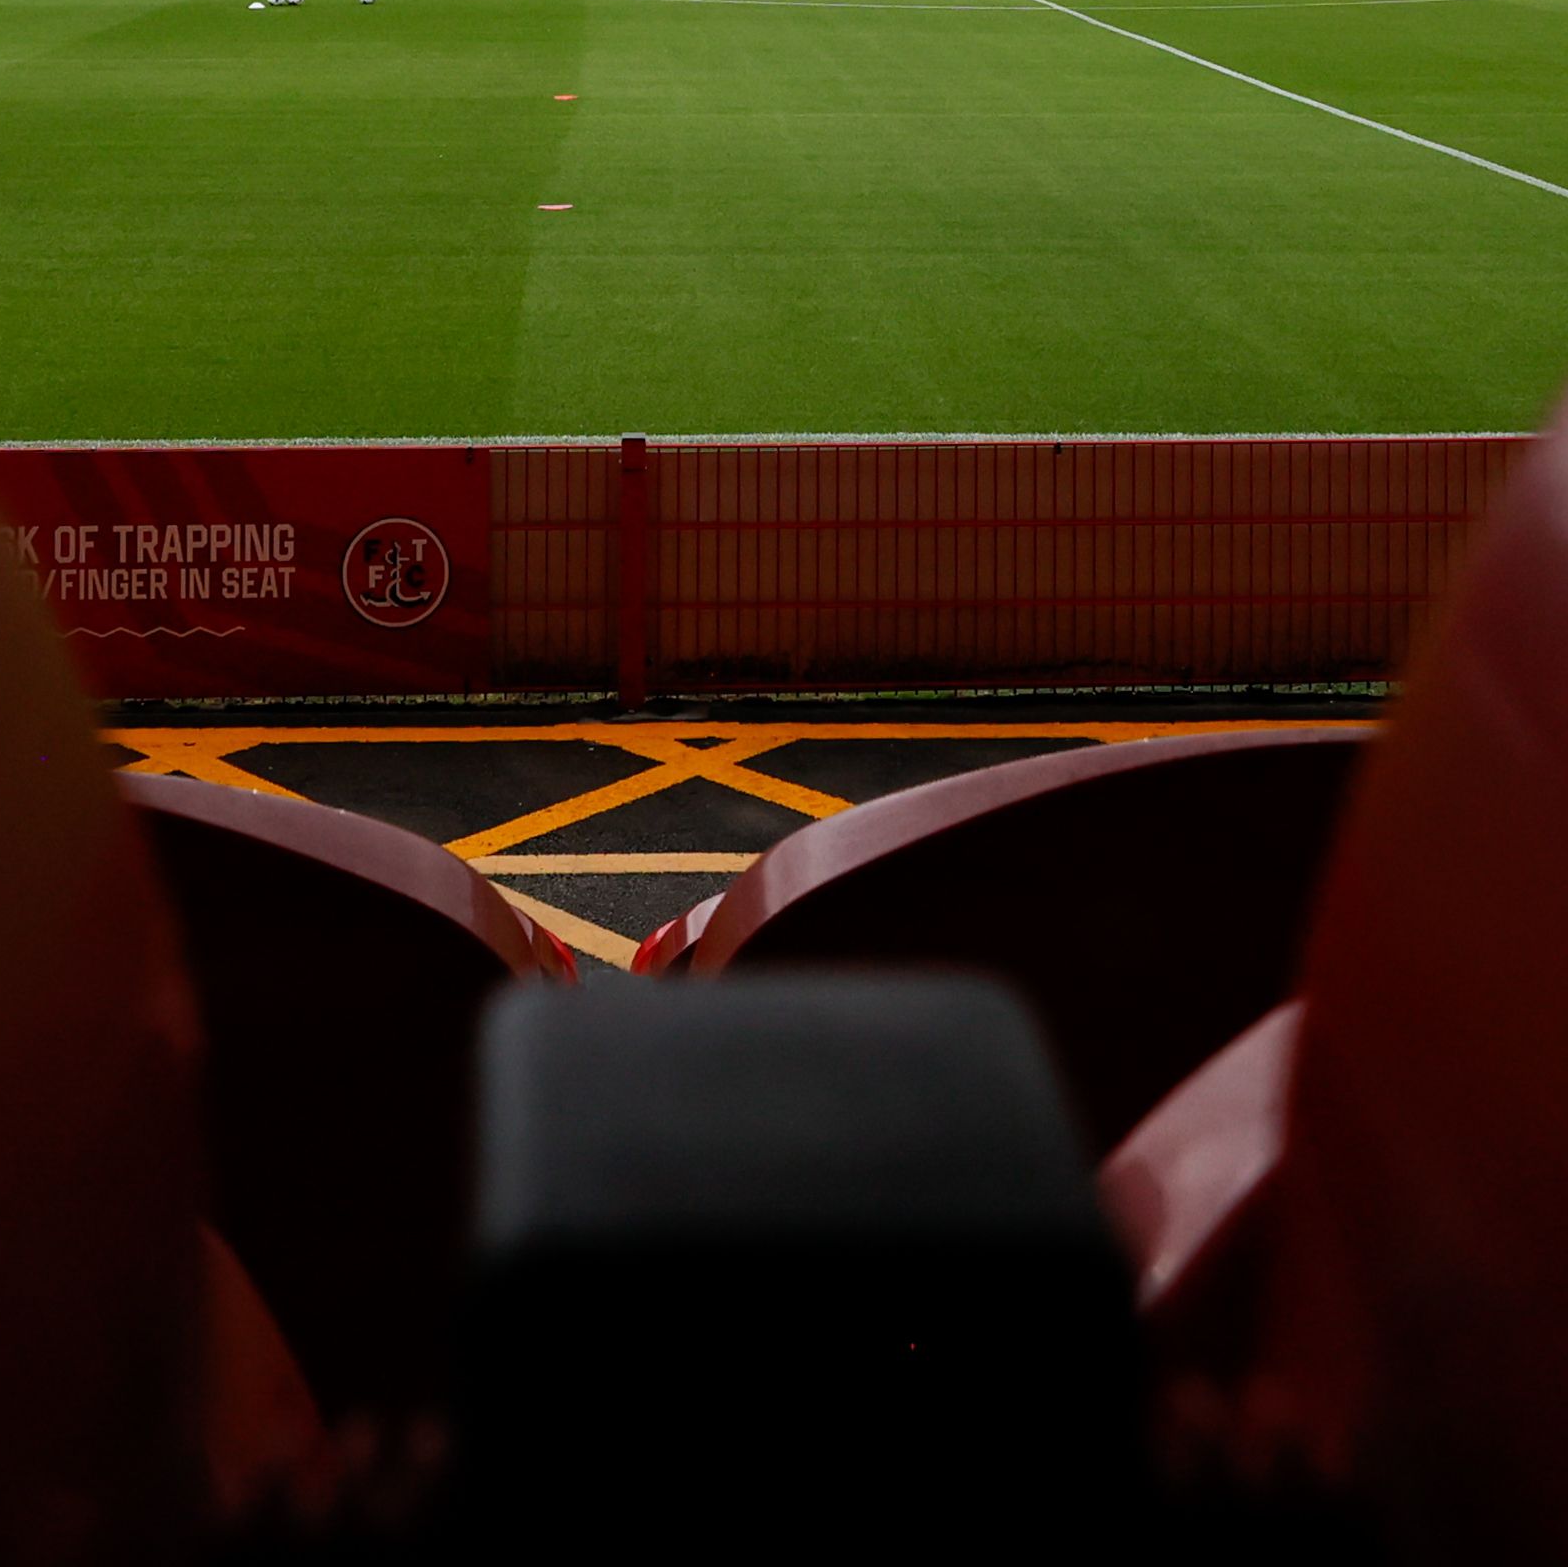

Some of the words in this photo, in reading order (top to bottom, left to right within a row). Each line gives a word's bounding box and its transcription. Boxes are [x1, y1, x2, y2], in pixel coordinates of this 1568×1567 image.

[53, 524, 99, 564] OF
[112, 523, 295, 563] TRAPPING
[179, 568, 210, 600] IN
[222, 567, 296, 600] SEAT
